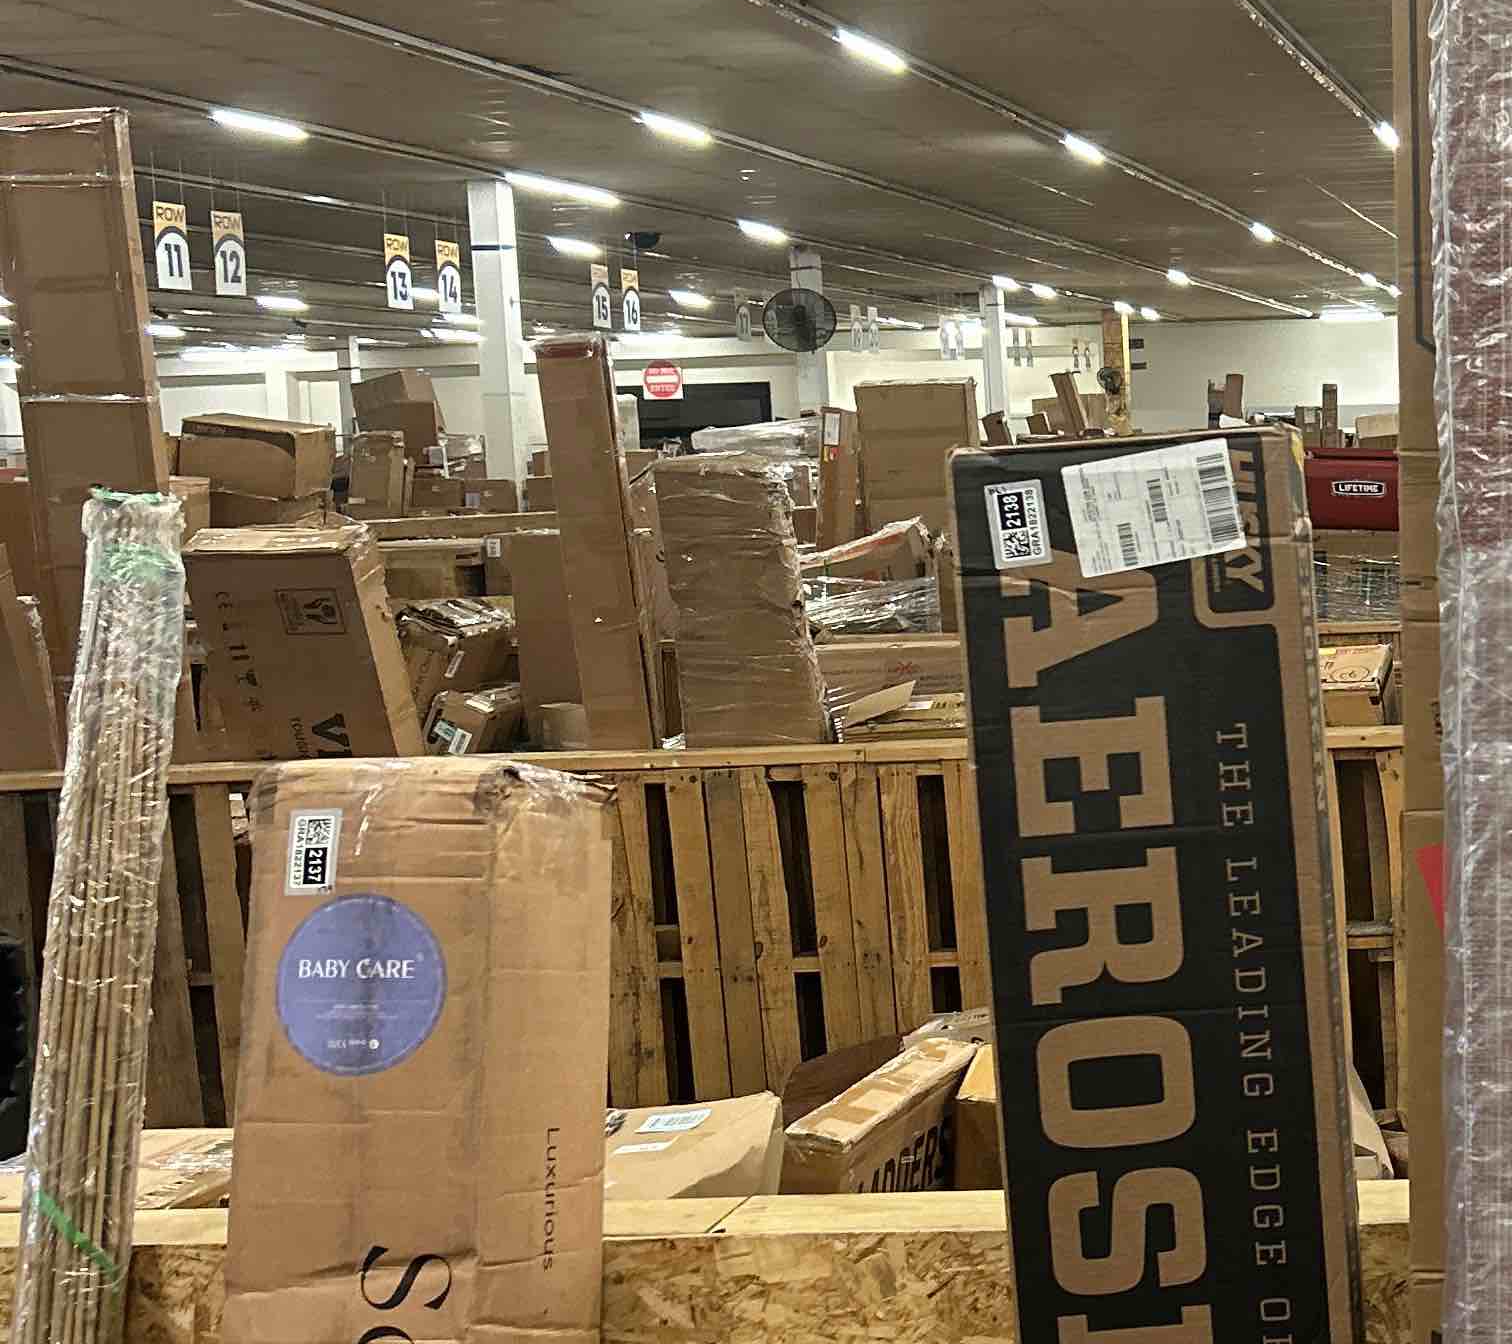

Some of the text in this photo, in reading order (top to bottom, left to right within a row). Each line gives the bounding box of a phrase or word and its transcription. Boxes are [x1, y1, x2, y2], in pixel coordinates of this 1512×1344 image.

[156, 206, 185, 222] ROW
[213, 214, 240, 230] ROW
[385, 237, 408, 251] ROW
[164, 243, 184, 278] 11
[219, 250, 241, 284] 12
[391, 270, 408, 301] 13
[441, 273, 457, 303] 14
[595, 294, 609, 321] 15
[625, 299, 638, 325] 16
[1338, 484, 1379, 493] LIFETIME
[1004, 494, 1022, 528] 2138
[1215, 723, 1254, 826] THE
[307, 849, 324, 882] 2137
[298, 958, 416, 979] BABY CARE
[1225, 857, 1275, 1097] LEADING
[542, 1126, 561, 1272] Luxurious
[1245, 1129, 1286, 1266] EDGE
